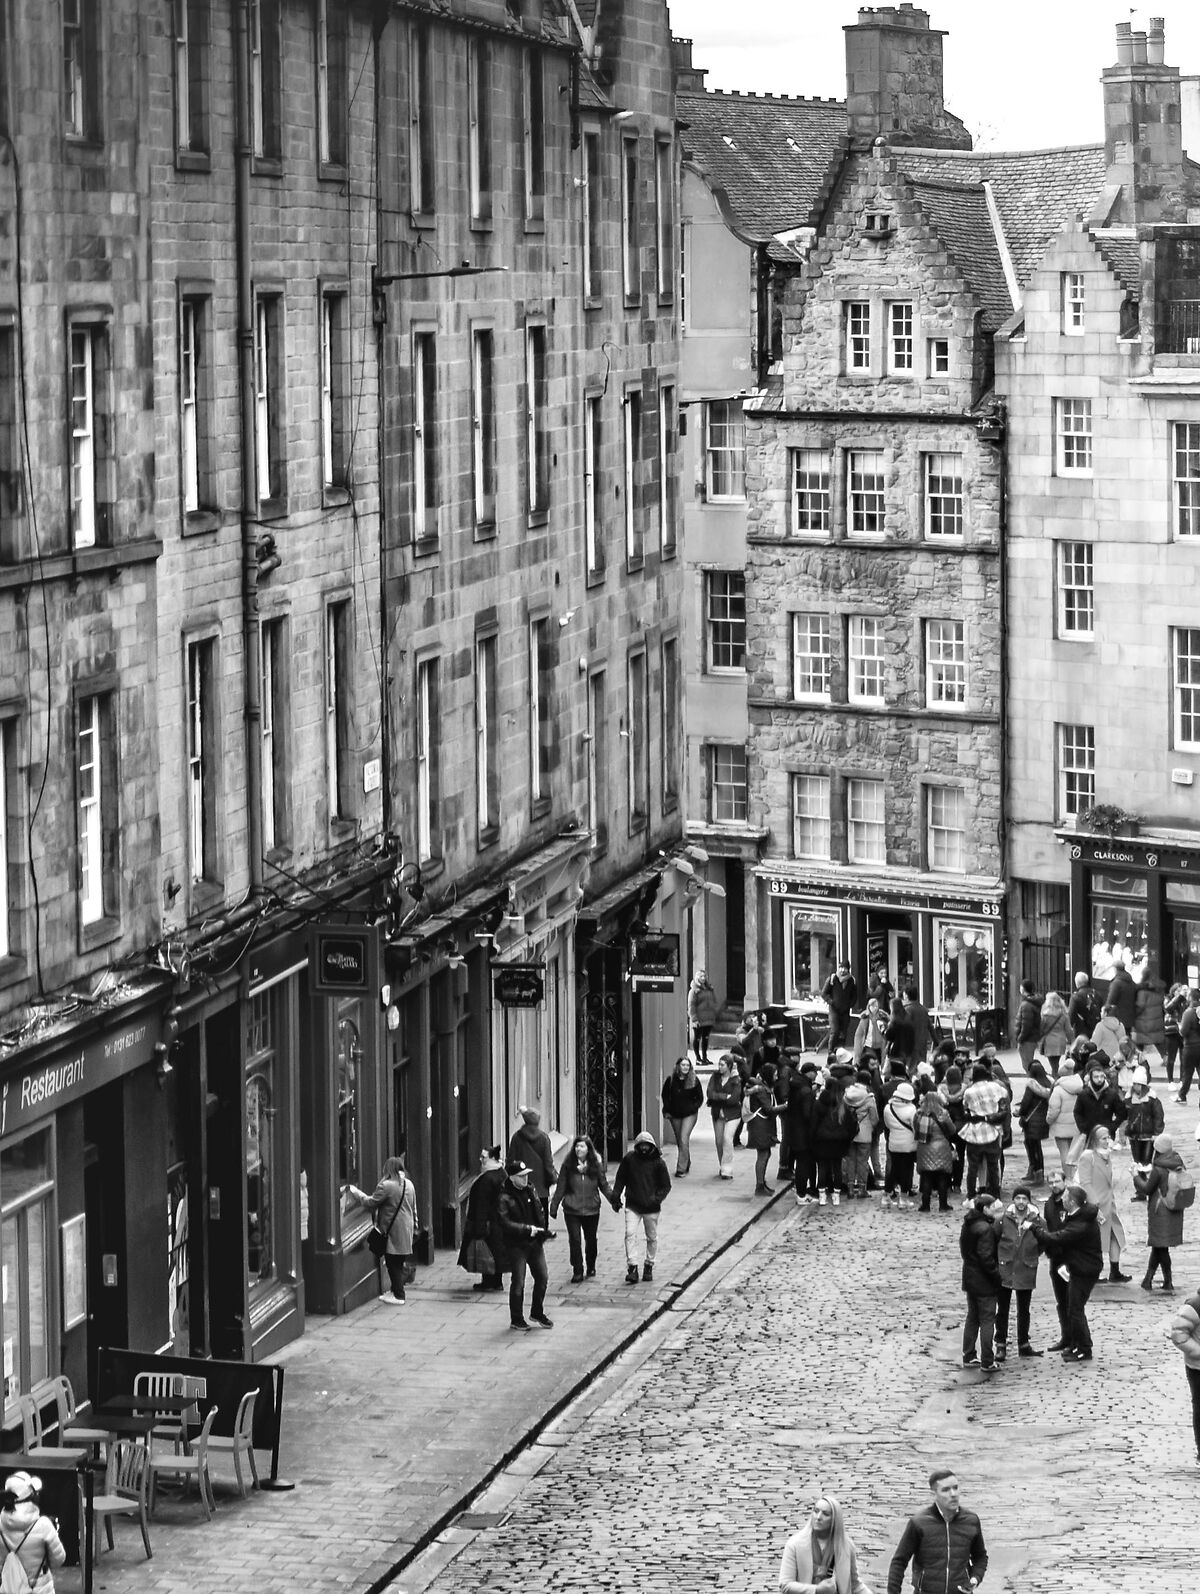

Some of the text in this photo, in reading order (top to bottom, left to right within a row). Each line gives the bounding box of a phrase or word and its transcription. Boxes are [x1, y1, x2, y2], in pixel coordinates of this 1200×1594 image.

[1094, 851, 1134, 862] CLARKSONS
[771, 881, 829, 896] 89 boulangerie
[982, 903, 999, 915] 89
[21, 1050, 85, 1110] Restaurant
